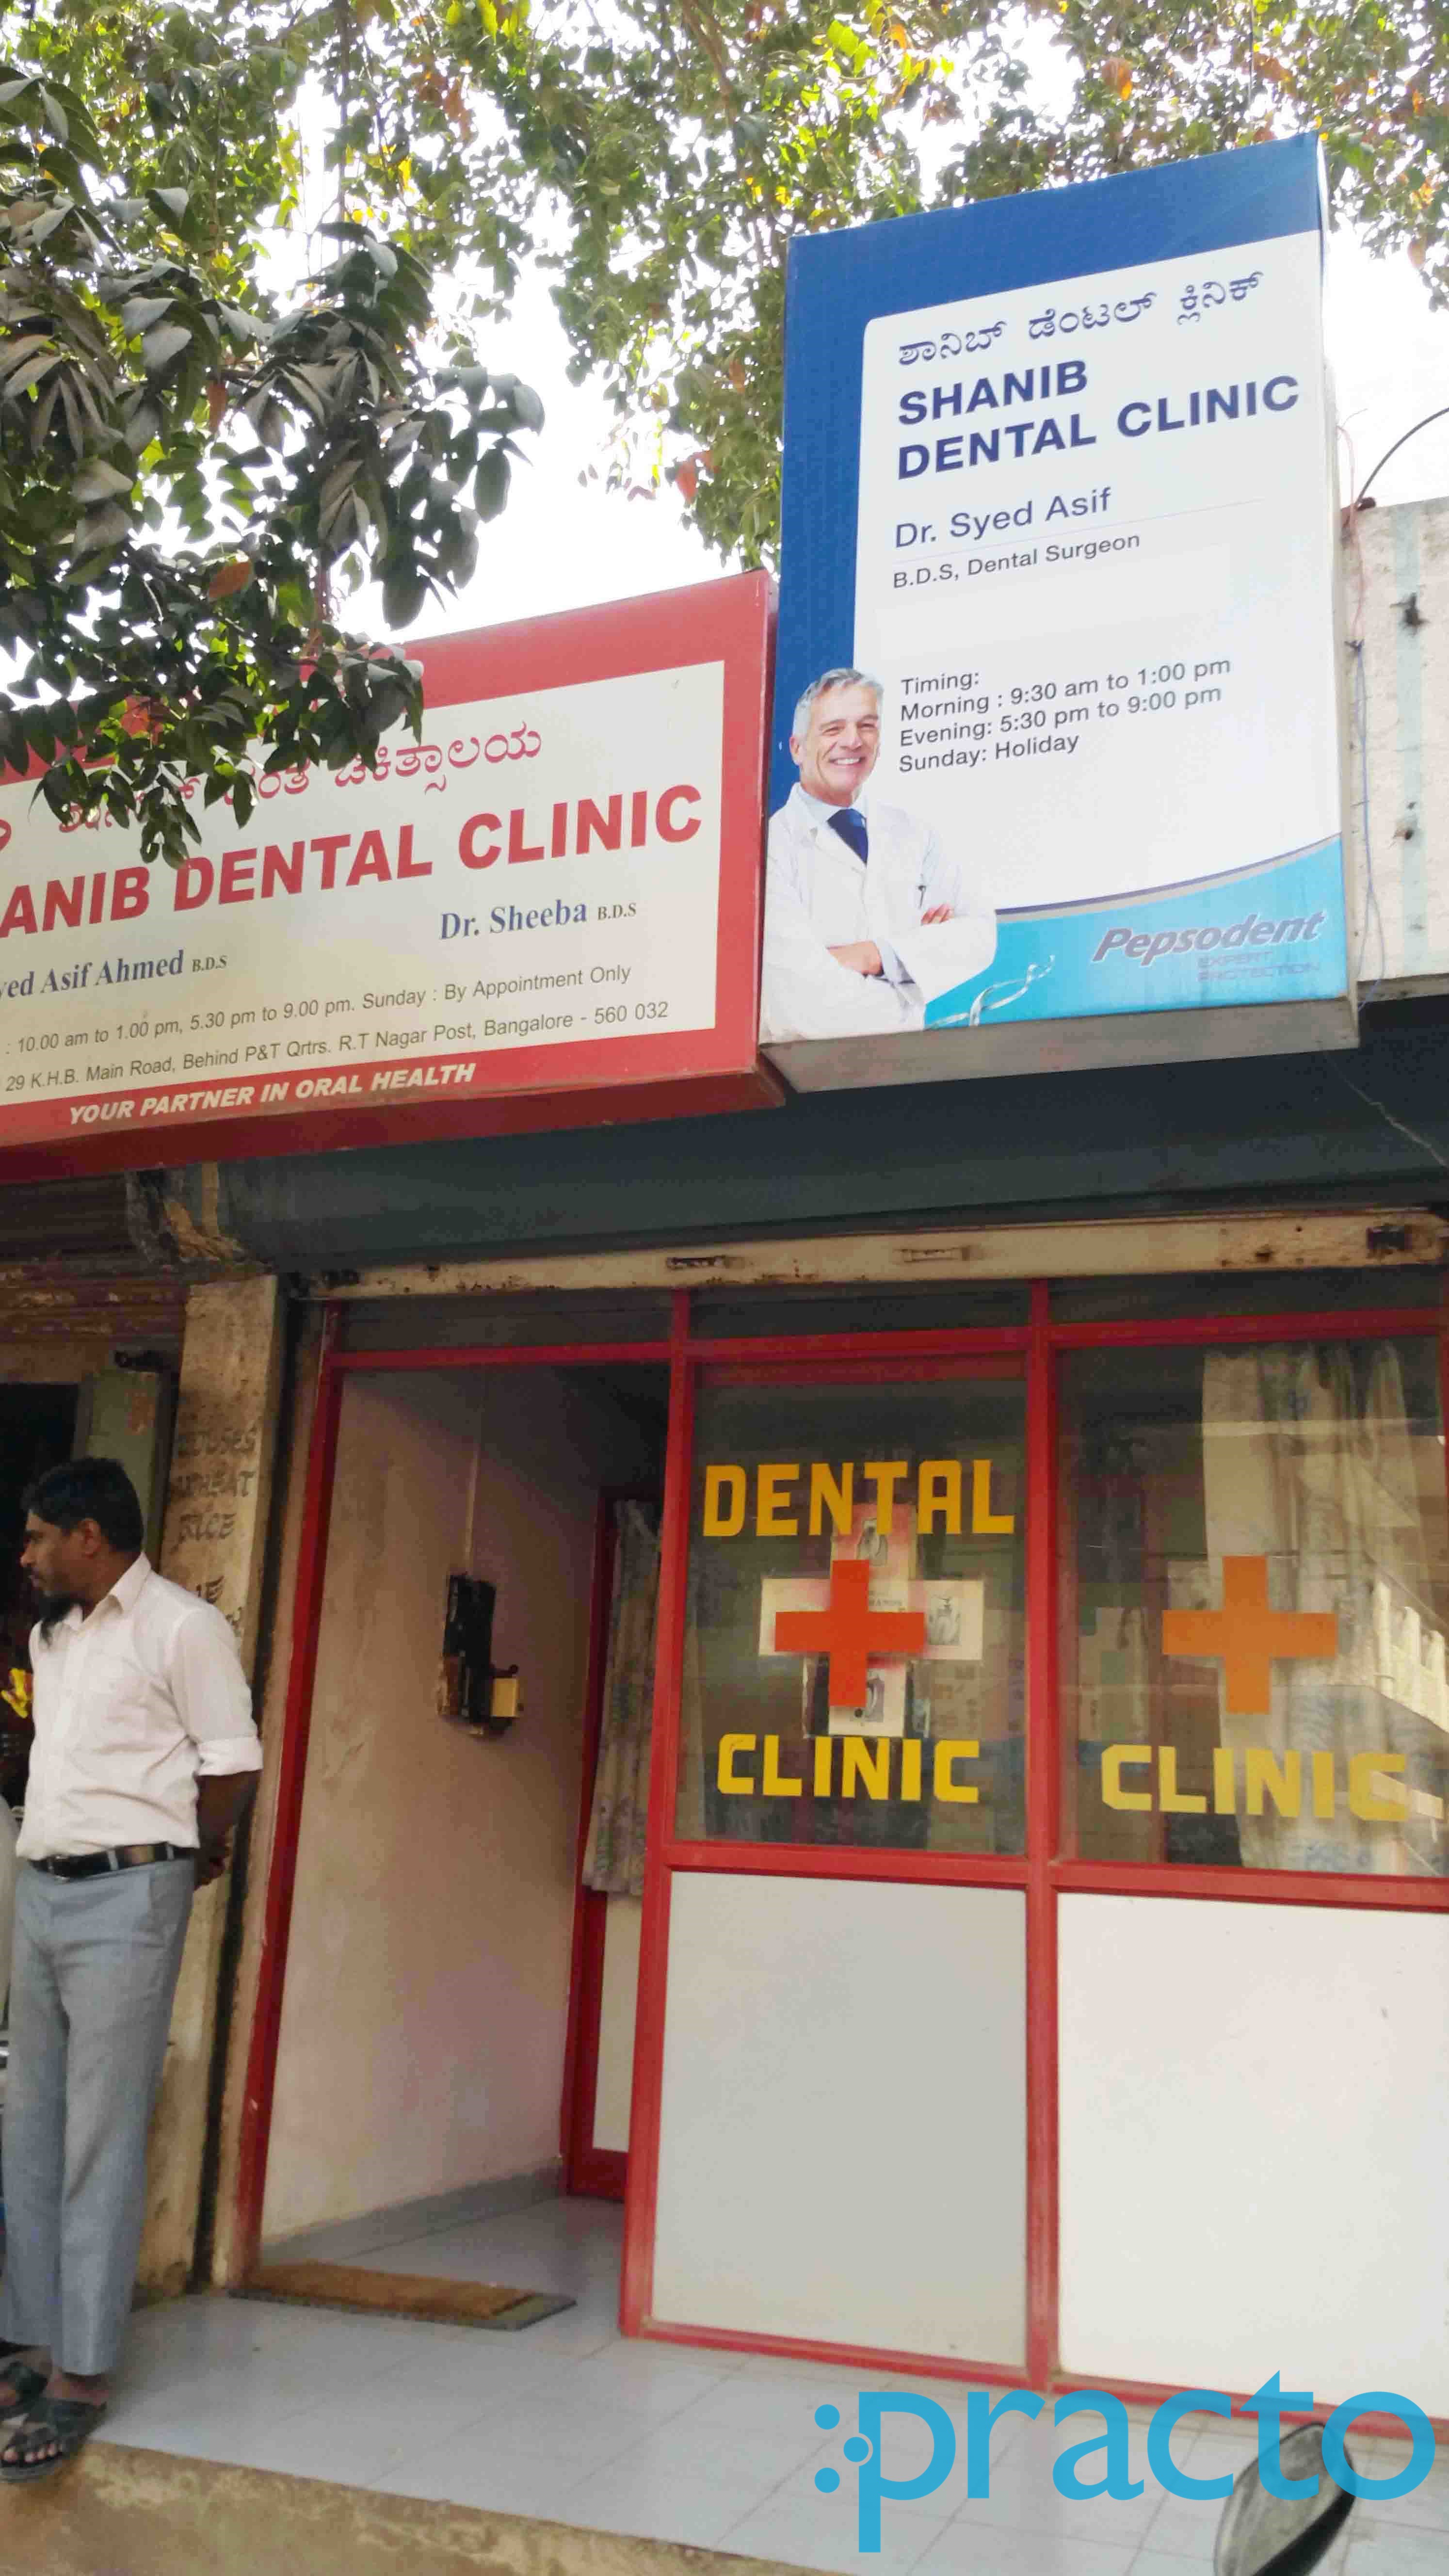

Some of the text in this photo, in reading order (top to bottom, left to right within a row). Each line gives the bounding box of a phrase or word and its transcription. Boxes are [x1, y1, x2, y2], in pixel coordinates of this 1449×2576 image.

[898, 271, 1263, 365] ಶಾನಿಬ್ ಡೆಂಟಲ್ ಕ್ಲಿನಿಕ್
[897, 360, 1088, 425] SHANIB
[897, 375, 1300, 480] DENTAL CLINIC
[895, 486, 1111, 548] Dr. Syed Asif
[893, 534, 1140, 588] B.D.S, Dental Surgeon
[900, 693, 990, 721] Morning
[1010, 682, 1057, 705] 9:30
[1064, 679, 1099, 697] am
[1106, 673, 1129, 691] to
[1138, 662, 1185, 685] 1:00
[1193, 659, 1231, 683] pm
[901, 670, 980, 696] Timing:
[900, 687, 1222, 747] Evening: 5:30 pm to 9:00 pm
[899, 732, 1079, 773] Sunday: Holiday
[174, 823, 433, 912] DENTAL
[458, 784, 702, 870] CLINIC
[439, 899, 637, 940] Dr. Sheeba B.D.S
[1091, 910, 1326, 967] Pepsodent
[40, 962, 93, 993] Asif
[95, 950, 184, 985] Ahmed
[192, 955, 227, 972] B.D.S
[18, 1033, 59, 1052] 10.00
[64, 1030, 88, 1047] am
[95, 1026, 109, 1043] to
[116, 1021, 148, 1040] 1.00
[154, 1019, 183, 1038] pm,
[190, 1014, 225, 1030] 5.30
[230, 1009, 255, 1027] pm
[262, 1006, 277, 1021] to
[283, 999, 318, 1018] 9.00
[324, 998, 355, 1016] pm.
[363, 990, 426, 1009] Sunday
[444, 983, 466, 1003] By
[473, 969, 583, 999] Appointment
[590, 965, 631, 984] Only
[6, 1075, 25, 1092] 29
[31, 1068, 80, 1089] K.H.B.
[86, 1062, 124, 1082] Main
[129, 1057, 176, 1076] Road,
[183, 1049, 238, 1069] Behind
[245, 1043, 279, 1062] P&T
[287, 1038, 331, 1057] Qrtrs.
[339, 1033, 369, 1052] R.T
[375, 1028, 427, 1050] Nagar
[434, 1023, 476, 1042] Post,
[484, 1013, 573, 1037] Bangalore
[594, 1006, 627, 1024] 560
[634, 1001, 669, 1019] 032
[70, 1063, 476, 1125] YOUR PARTNER IN ORAL HEALTH
[702, 1460, 1015, 1537] DENTAL
[717, 1734, 980, 1803] CLINIC
[1101, 1744, 1409, 1822] CLINIC
